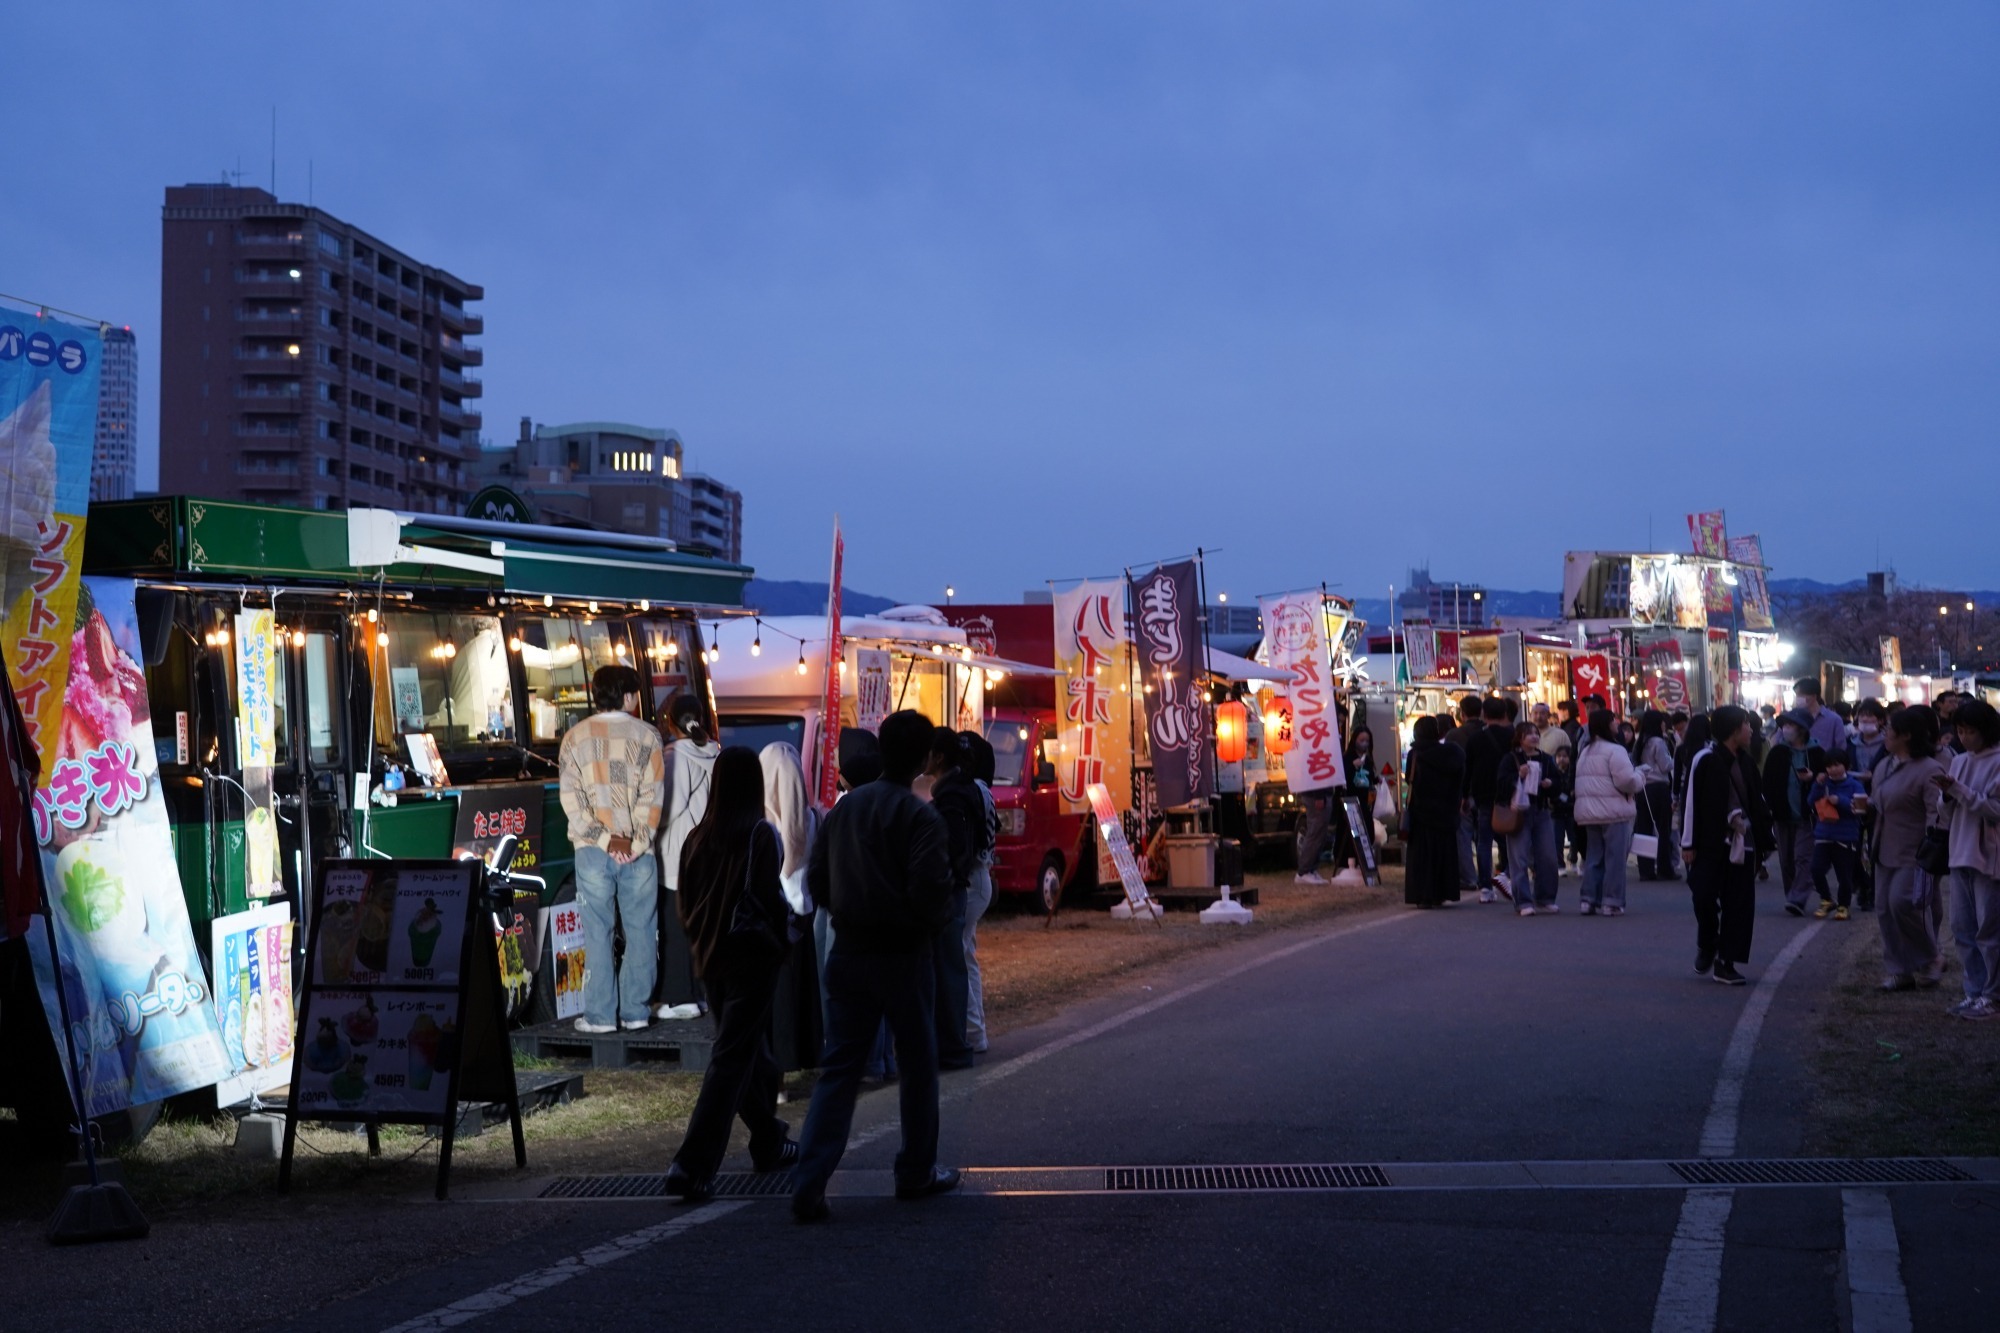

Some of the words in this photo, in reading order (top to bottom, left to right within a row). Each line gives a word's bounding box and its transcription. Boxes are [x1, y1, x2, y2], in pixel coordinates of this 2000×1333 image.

[0, 332, 82, 369] バニラ
[257, 634, 268, 722] はちみつ入り
[242, 635, 261, 757] レモネード
[474, 807, 526, 839] たこ焼き
[413, 873, 458, 882] クリームソーダ
[226, 938, 239, 993] ソーダ
[405, 968, 434, 980] 500円
[388, 1001, 434, 1011] レインボー
[378, 1037, 407, 1049] カキ氷
[374, 1074, 405, 1087] 450円
[301, 1091, 328, 1103] 500円
